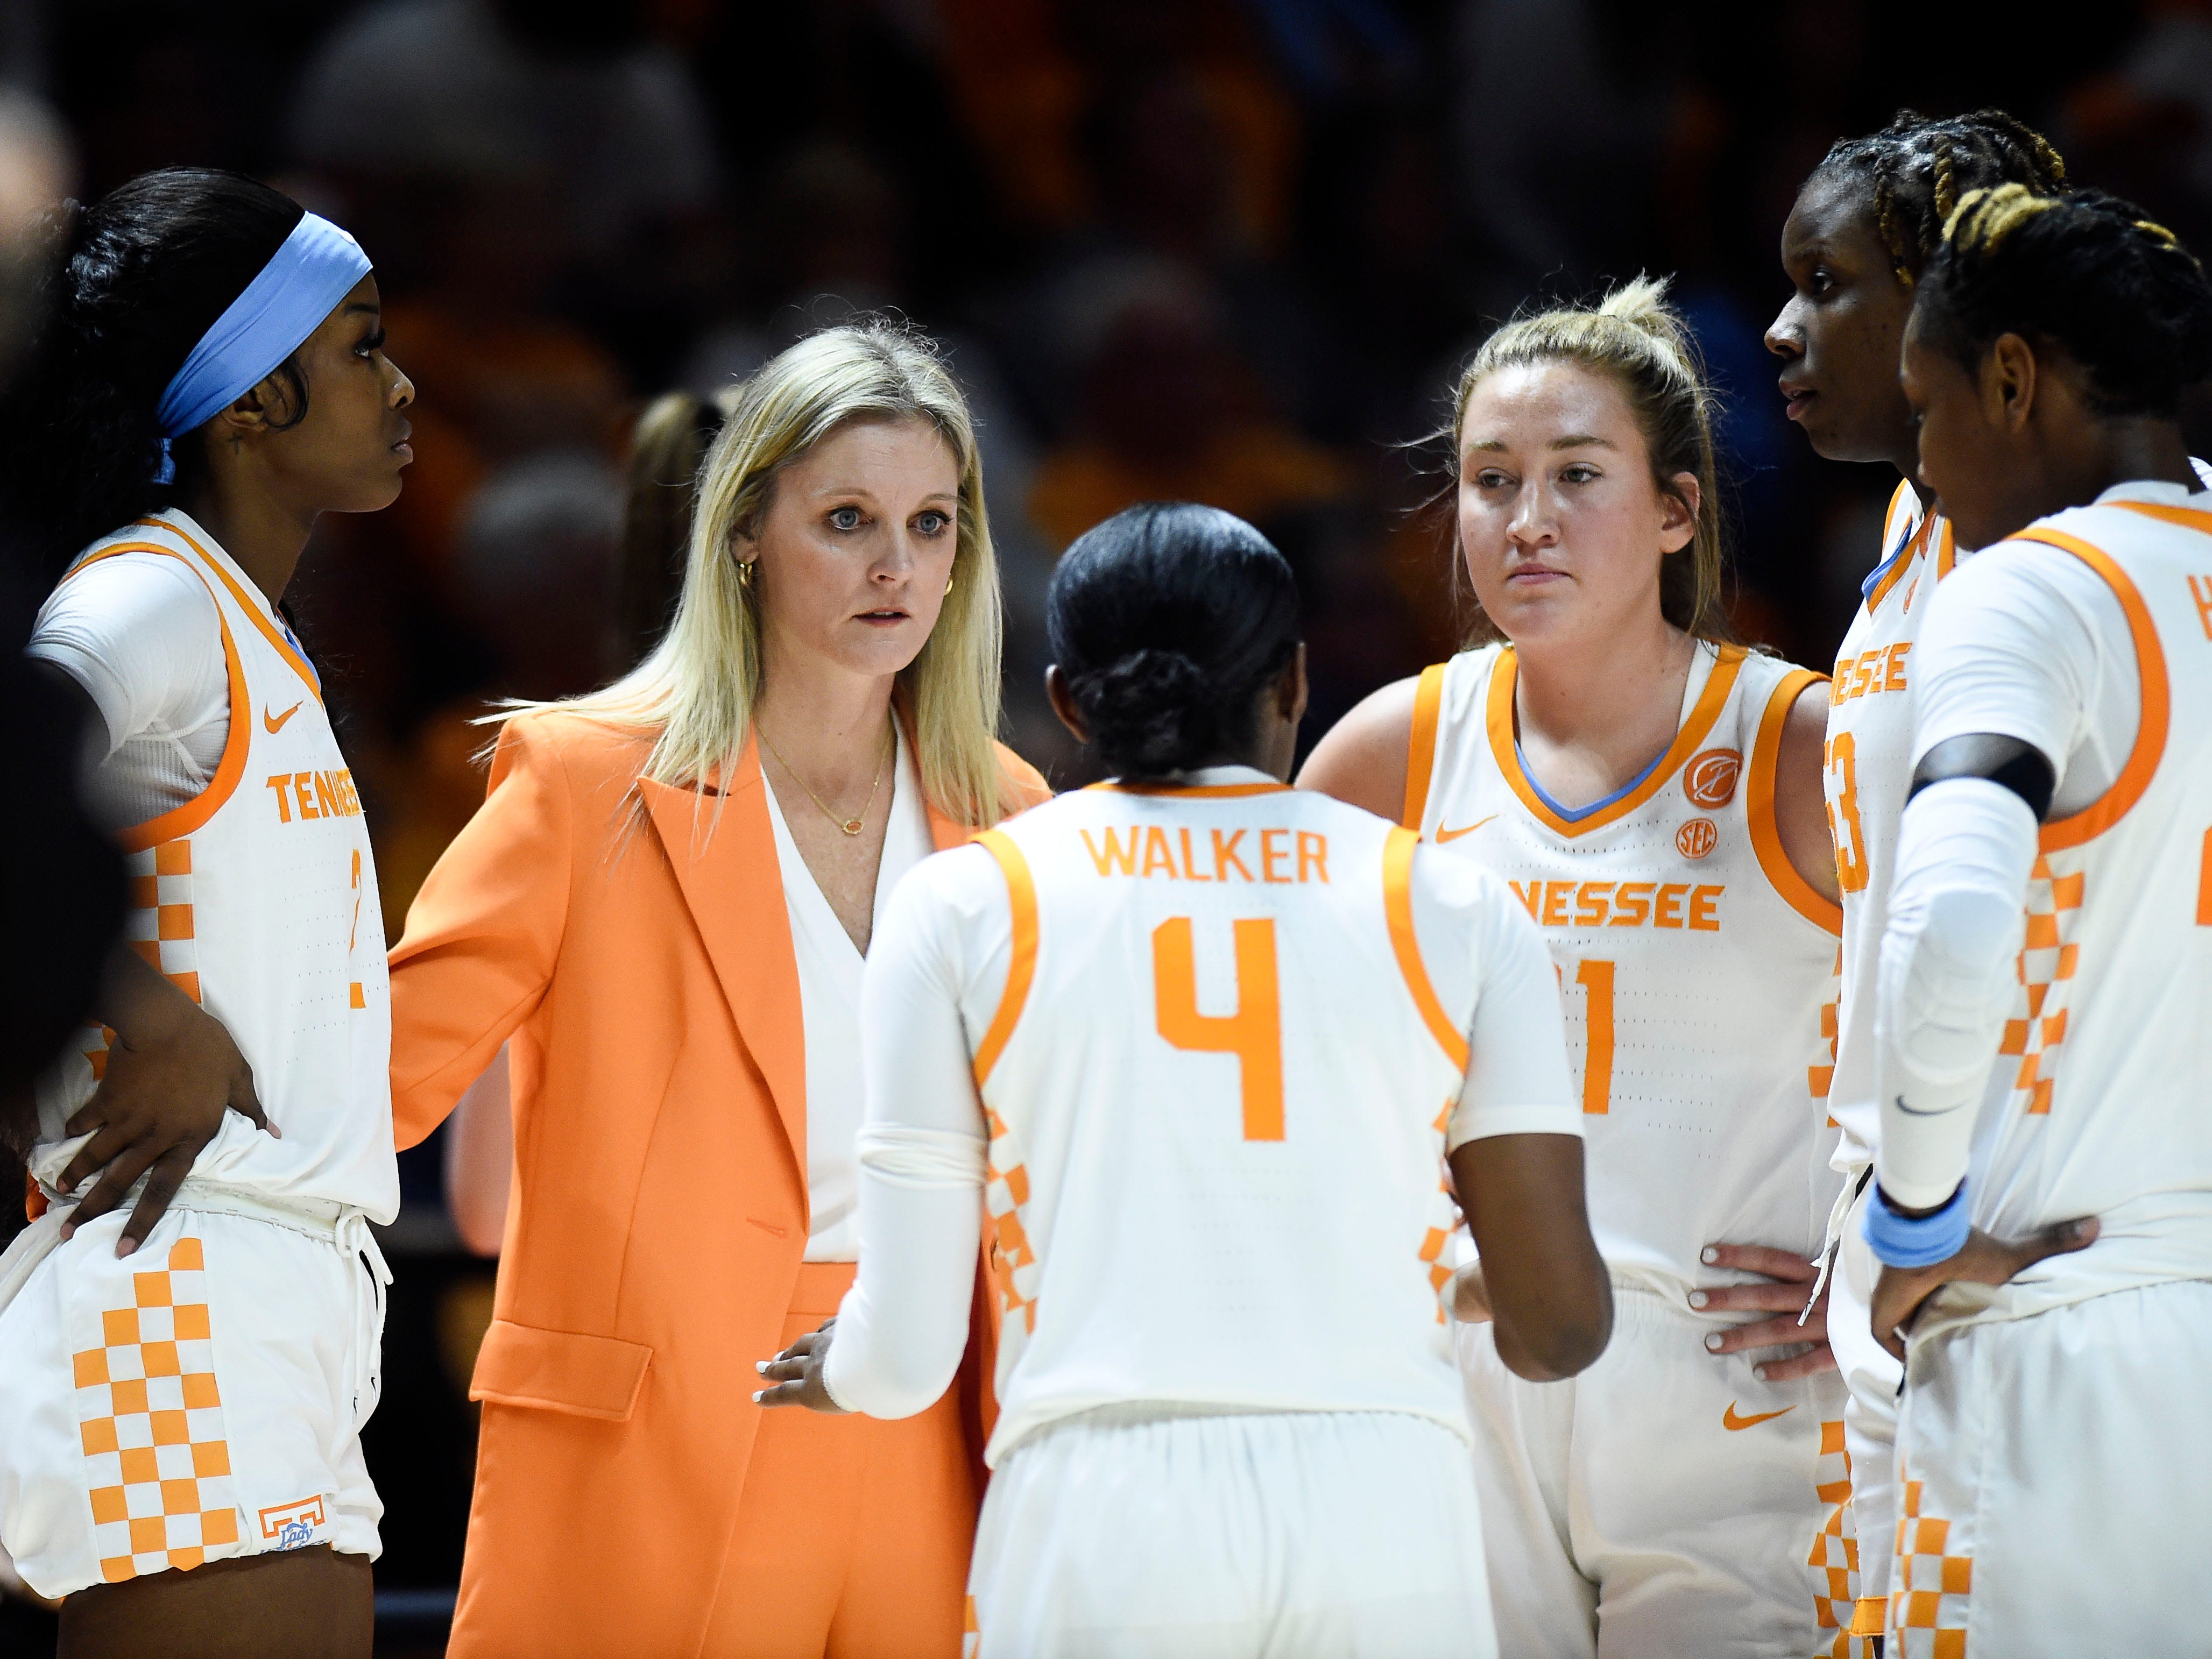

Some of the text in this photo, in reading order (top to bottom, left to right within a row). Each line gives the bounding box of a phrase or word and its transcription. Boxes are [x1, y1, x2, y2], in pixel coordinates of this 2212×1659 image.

[1080, 826, 1329, 883] WALKER
[1678, 820, 1715, 857] SEC
[1824, 731, 1869, 901] 3
[1152, 917, 1285, 1141] 4
